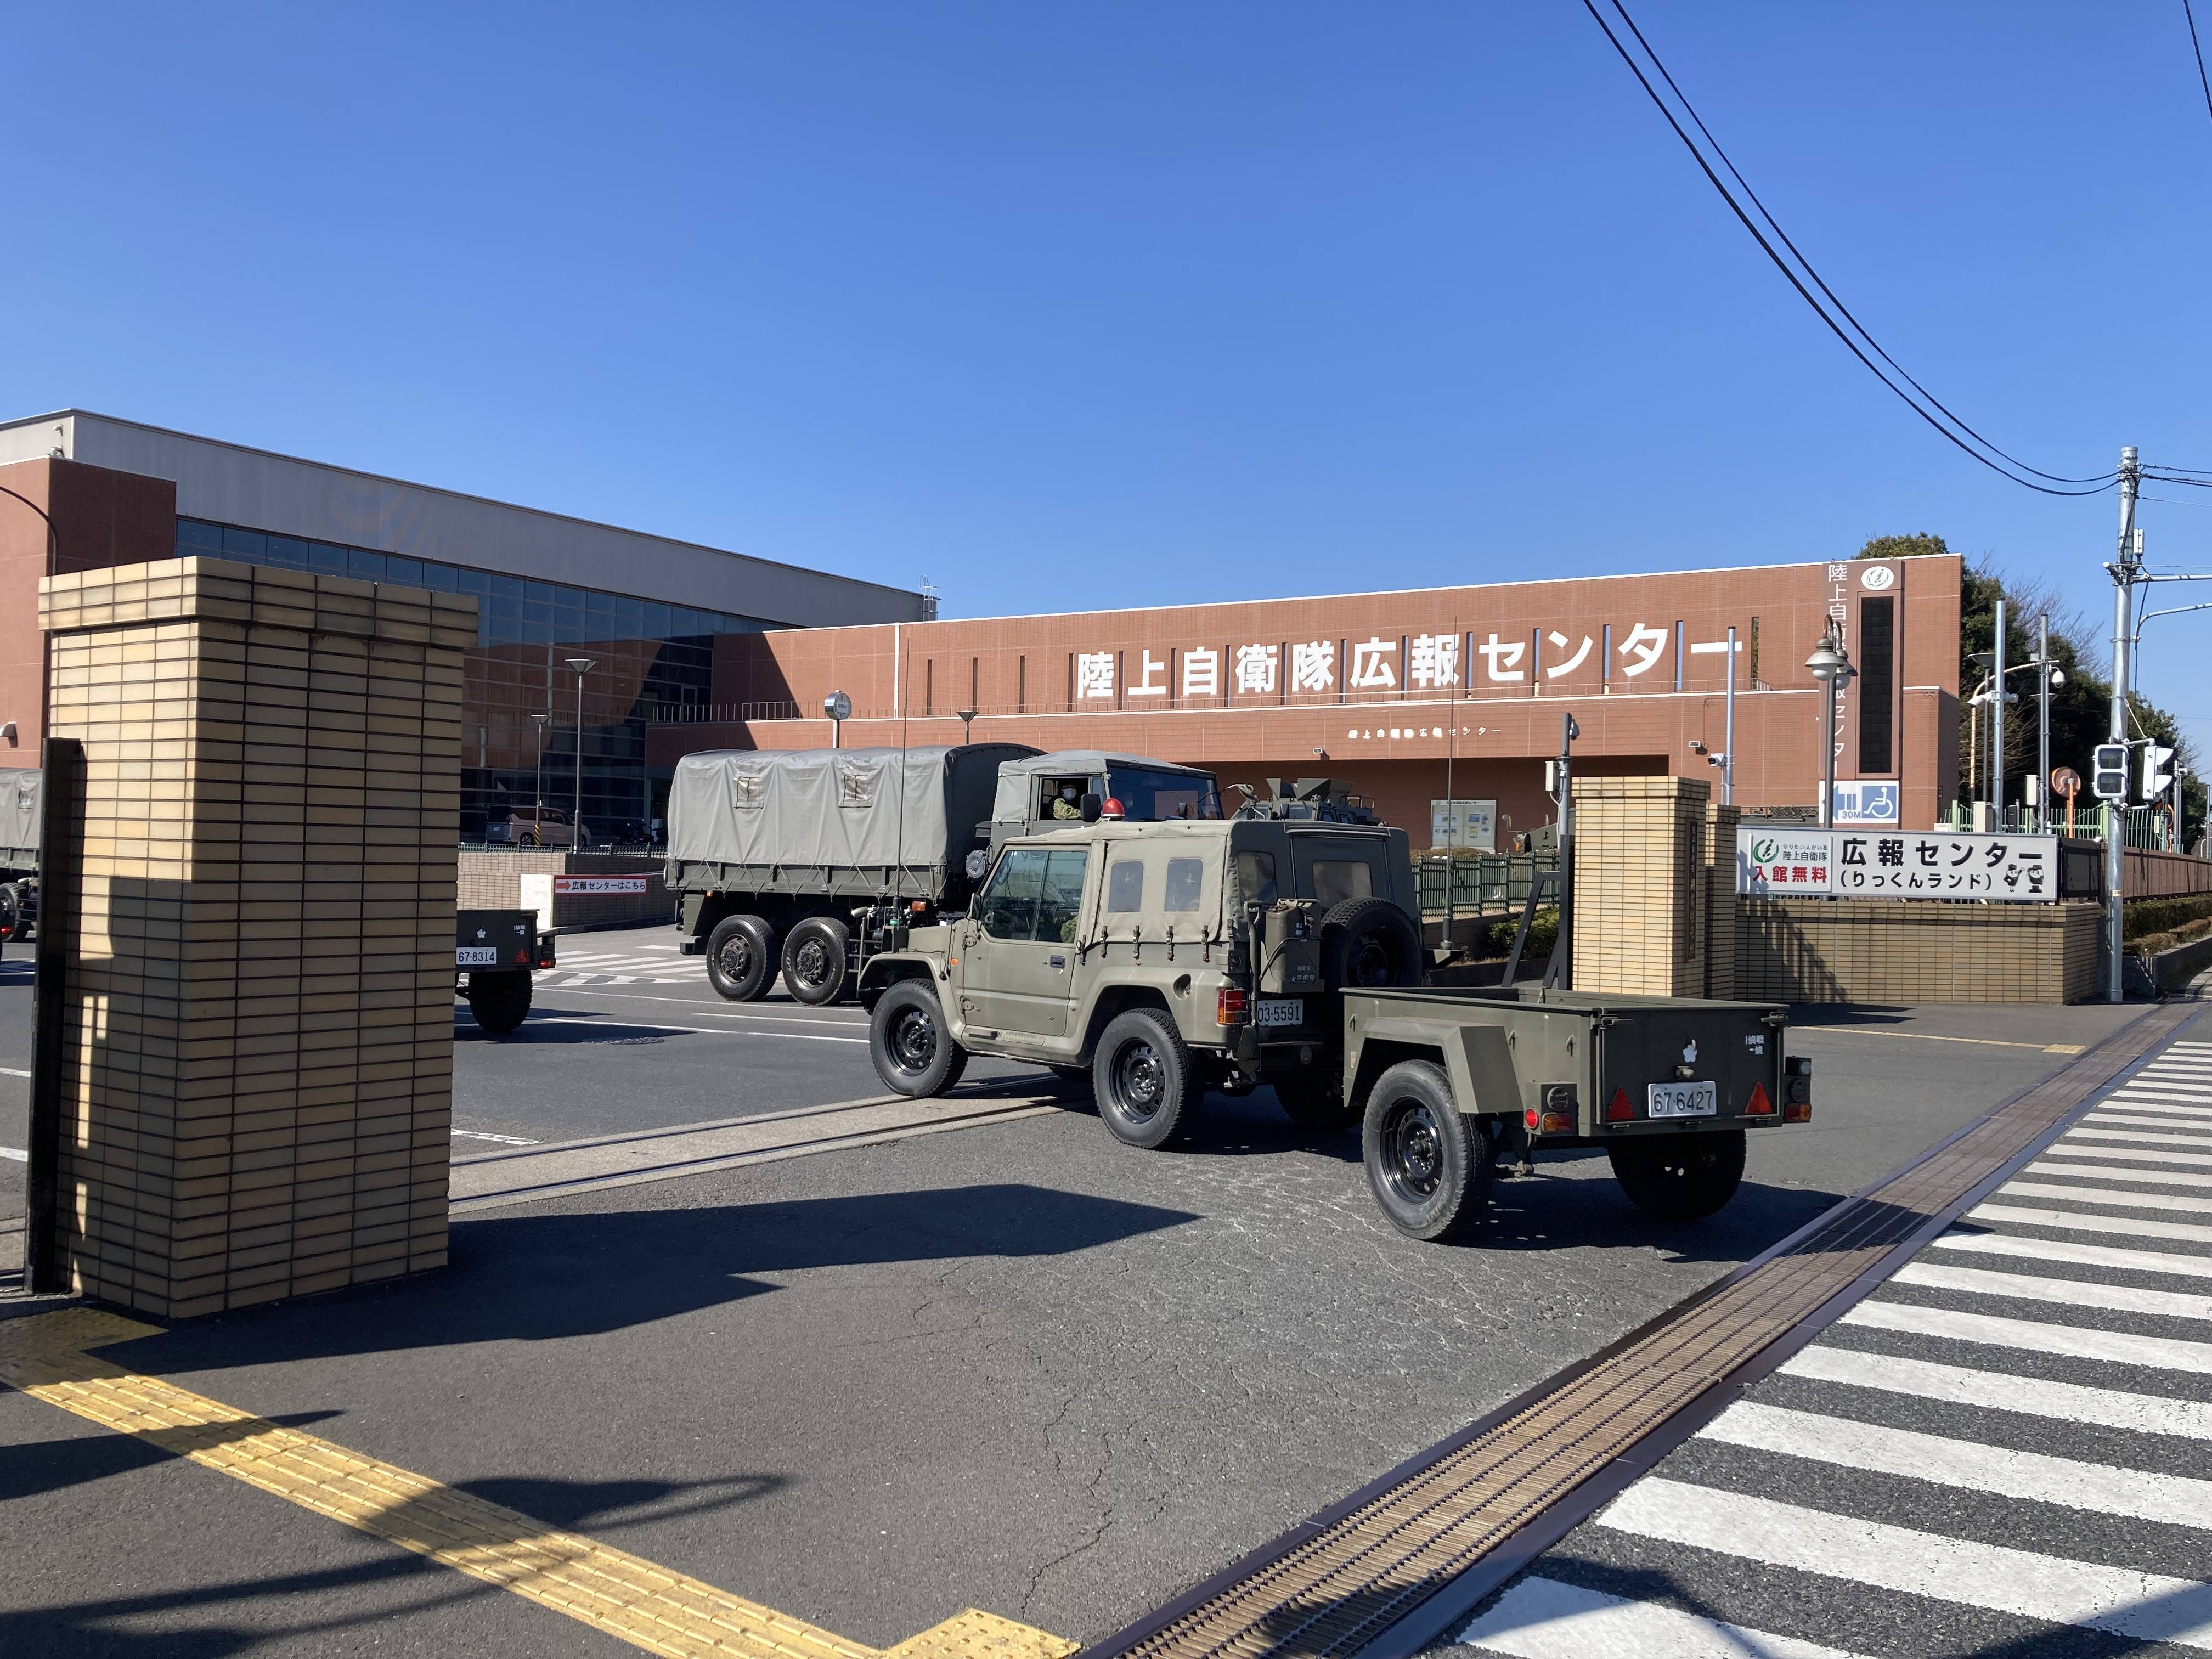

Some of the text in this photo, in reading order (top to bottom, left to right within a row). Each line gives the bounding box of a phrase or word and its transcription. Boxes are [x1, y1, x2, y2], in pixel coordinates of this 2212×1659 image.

[1077, 623, 1742, 699] 陸上自衛隊広報センター
[1783, 851, 1827, 861] 陸上自衛隊
[1841, 837, 2042, 868] 広報センター
[1753, 865, 1827, 883] 入館無料
[572, 881, 645, 890] 広報センターはこちら
[1257, 1005, 1300, 1022] 03-5591
